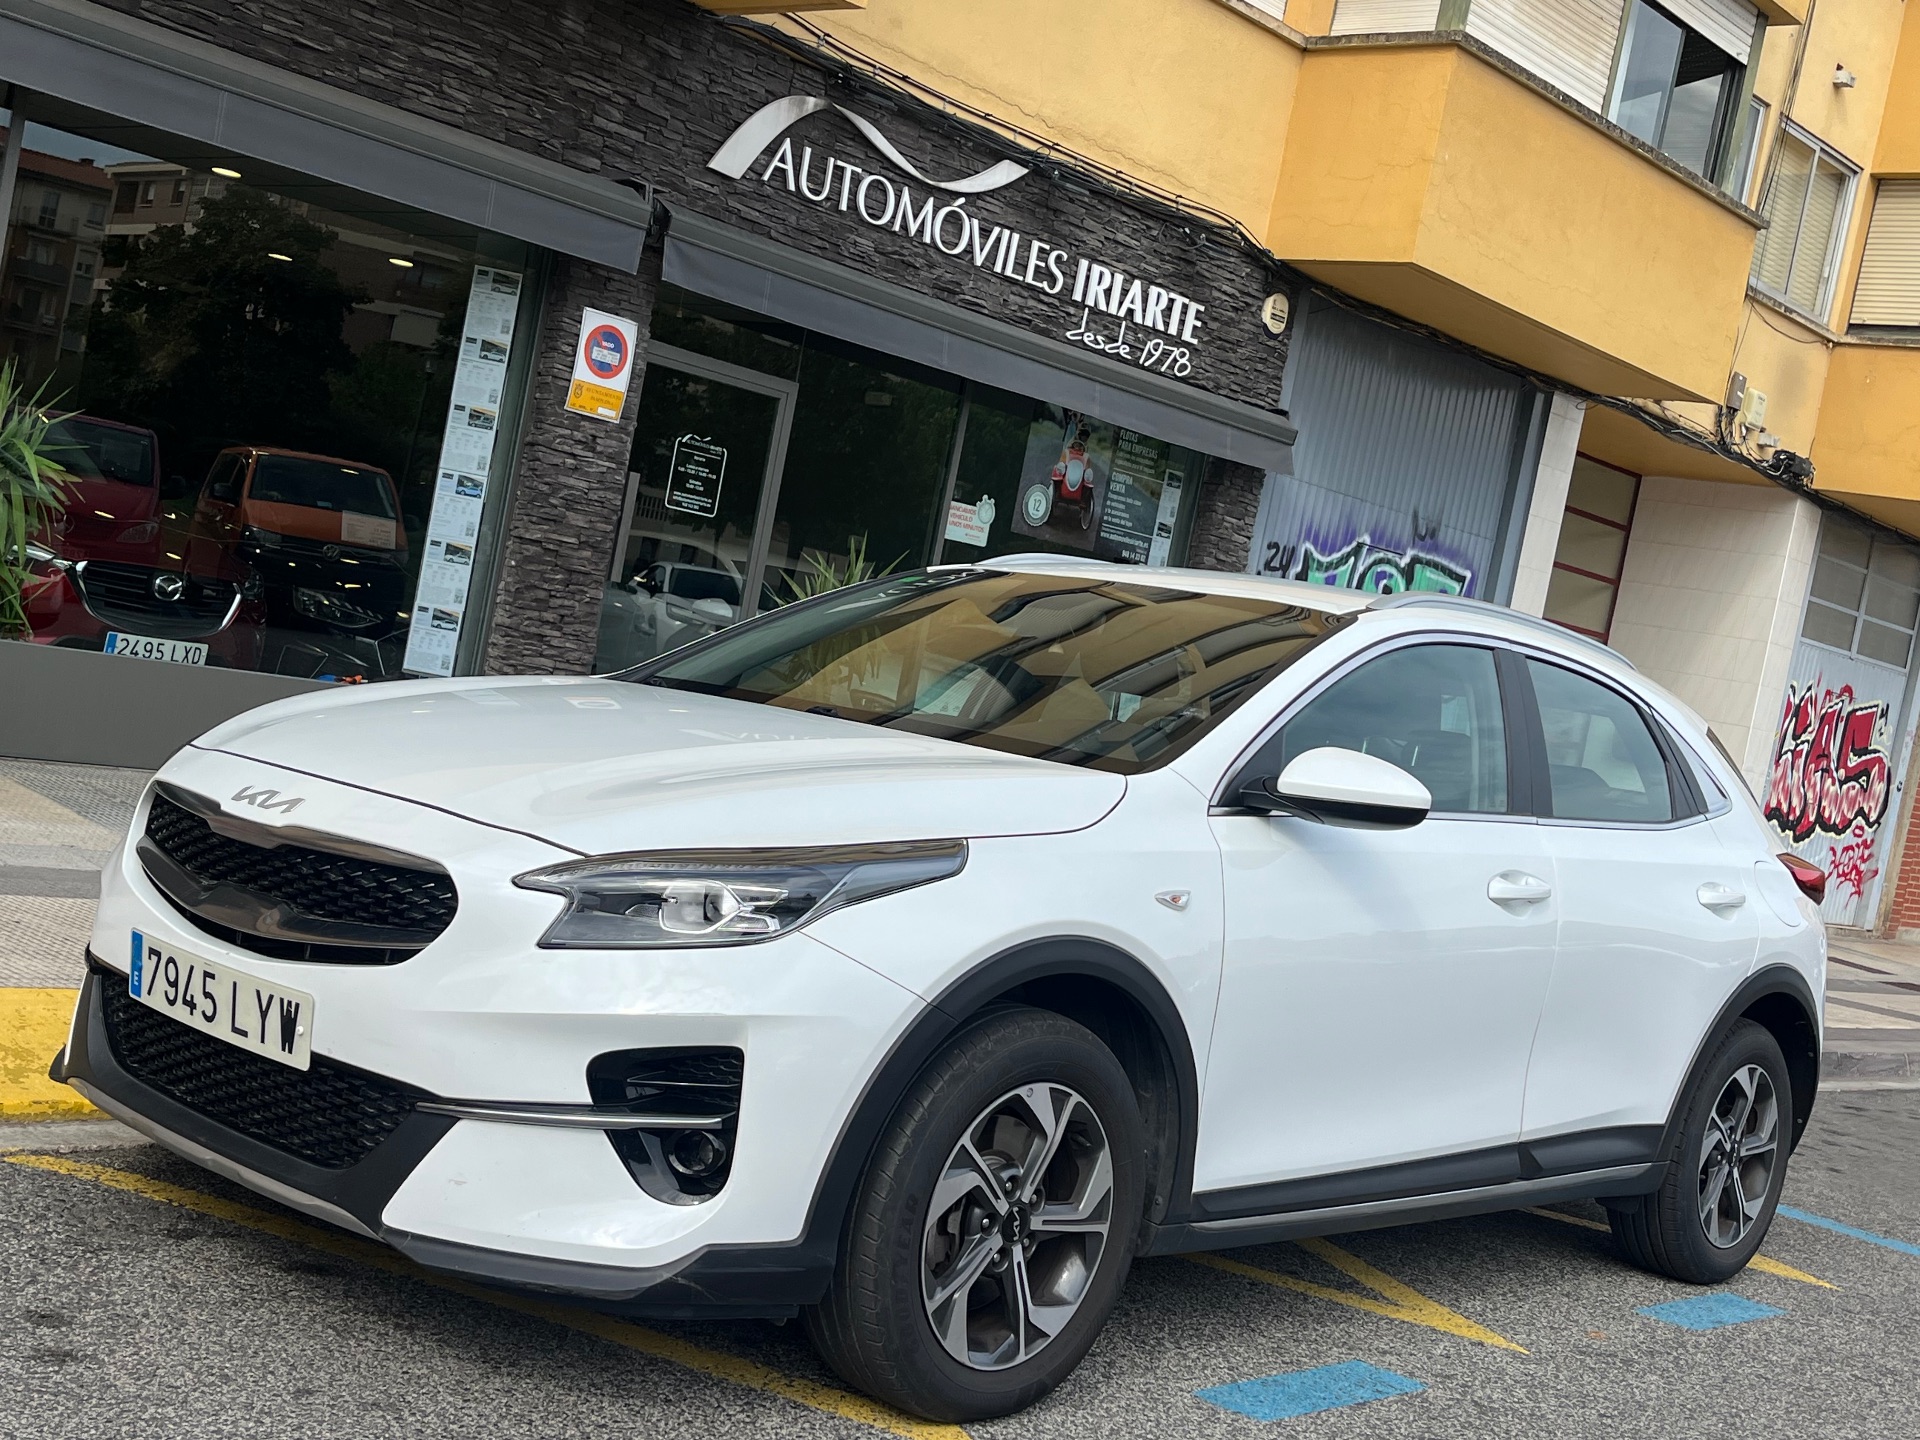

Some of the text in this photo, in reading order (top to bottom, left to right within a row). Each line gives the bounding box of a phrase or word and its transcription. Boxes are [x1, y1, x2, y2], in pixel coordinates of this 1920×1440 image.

[762, 138, 1205, 345] AUTOMÓVILES IRIARTE
[1066, 307, 1192, 376] desde 1978
[117, 638, 202, 665] 2495 LXD
[147, 946, 217, 1023] 7945
[231, 981, 300, 1055] LYW
